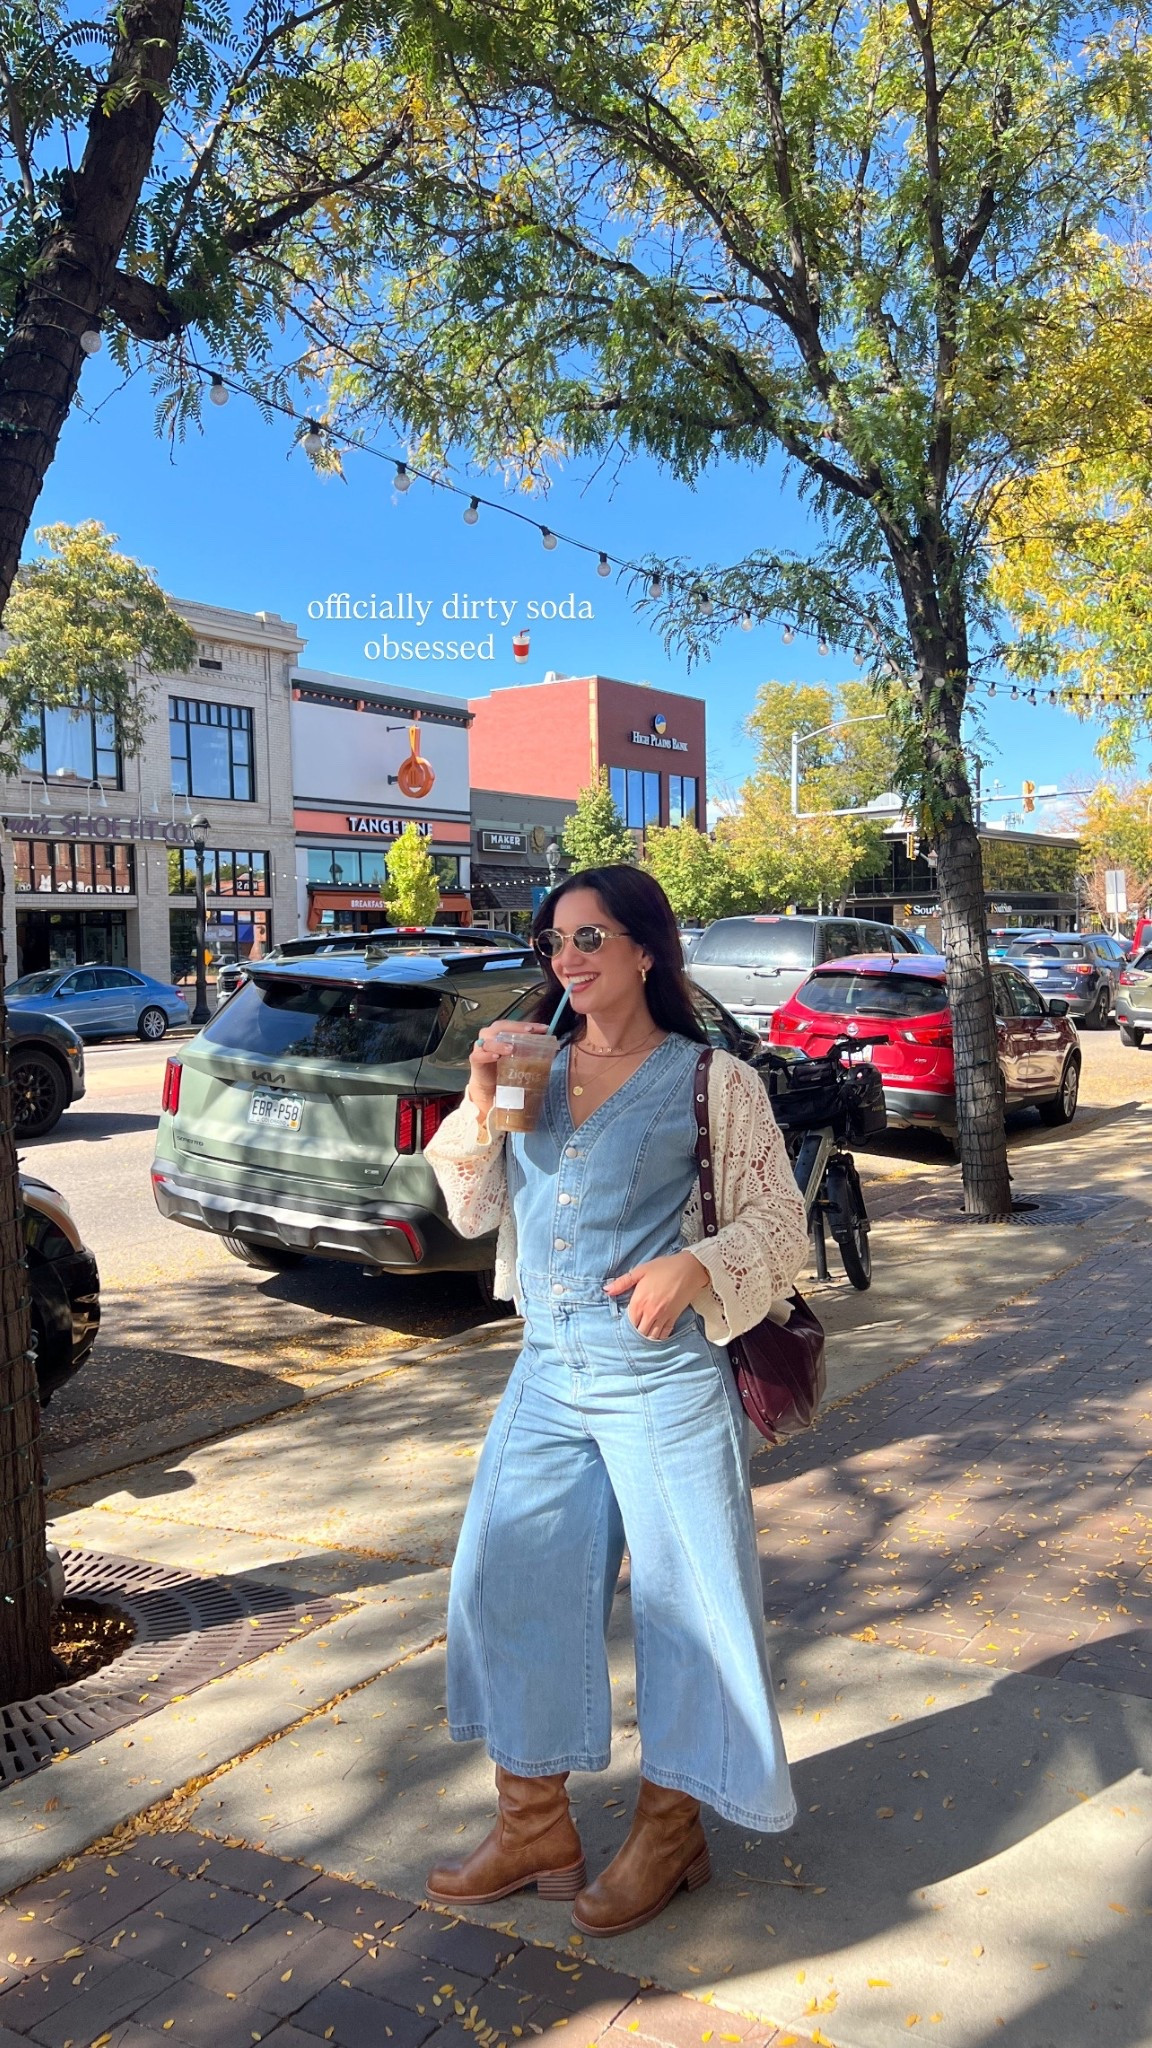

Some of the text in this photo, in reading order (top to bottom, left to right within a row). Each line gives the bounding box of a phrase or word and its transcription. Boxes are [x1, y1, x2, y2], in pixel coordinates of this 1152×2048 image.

[60, 811, 121, 839] SHOE
[129, 818, 159, 840] FIT
[348, 816, 434, 837] TANGENE
[490, 834, 521, 846] MAKER
[351, 899, 387, 909] BREAKFAS
